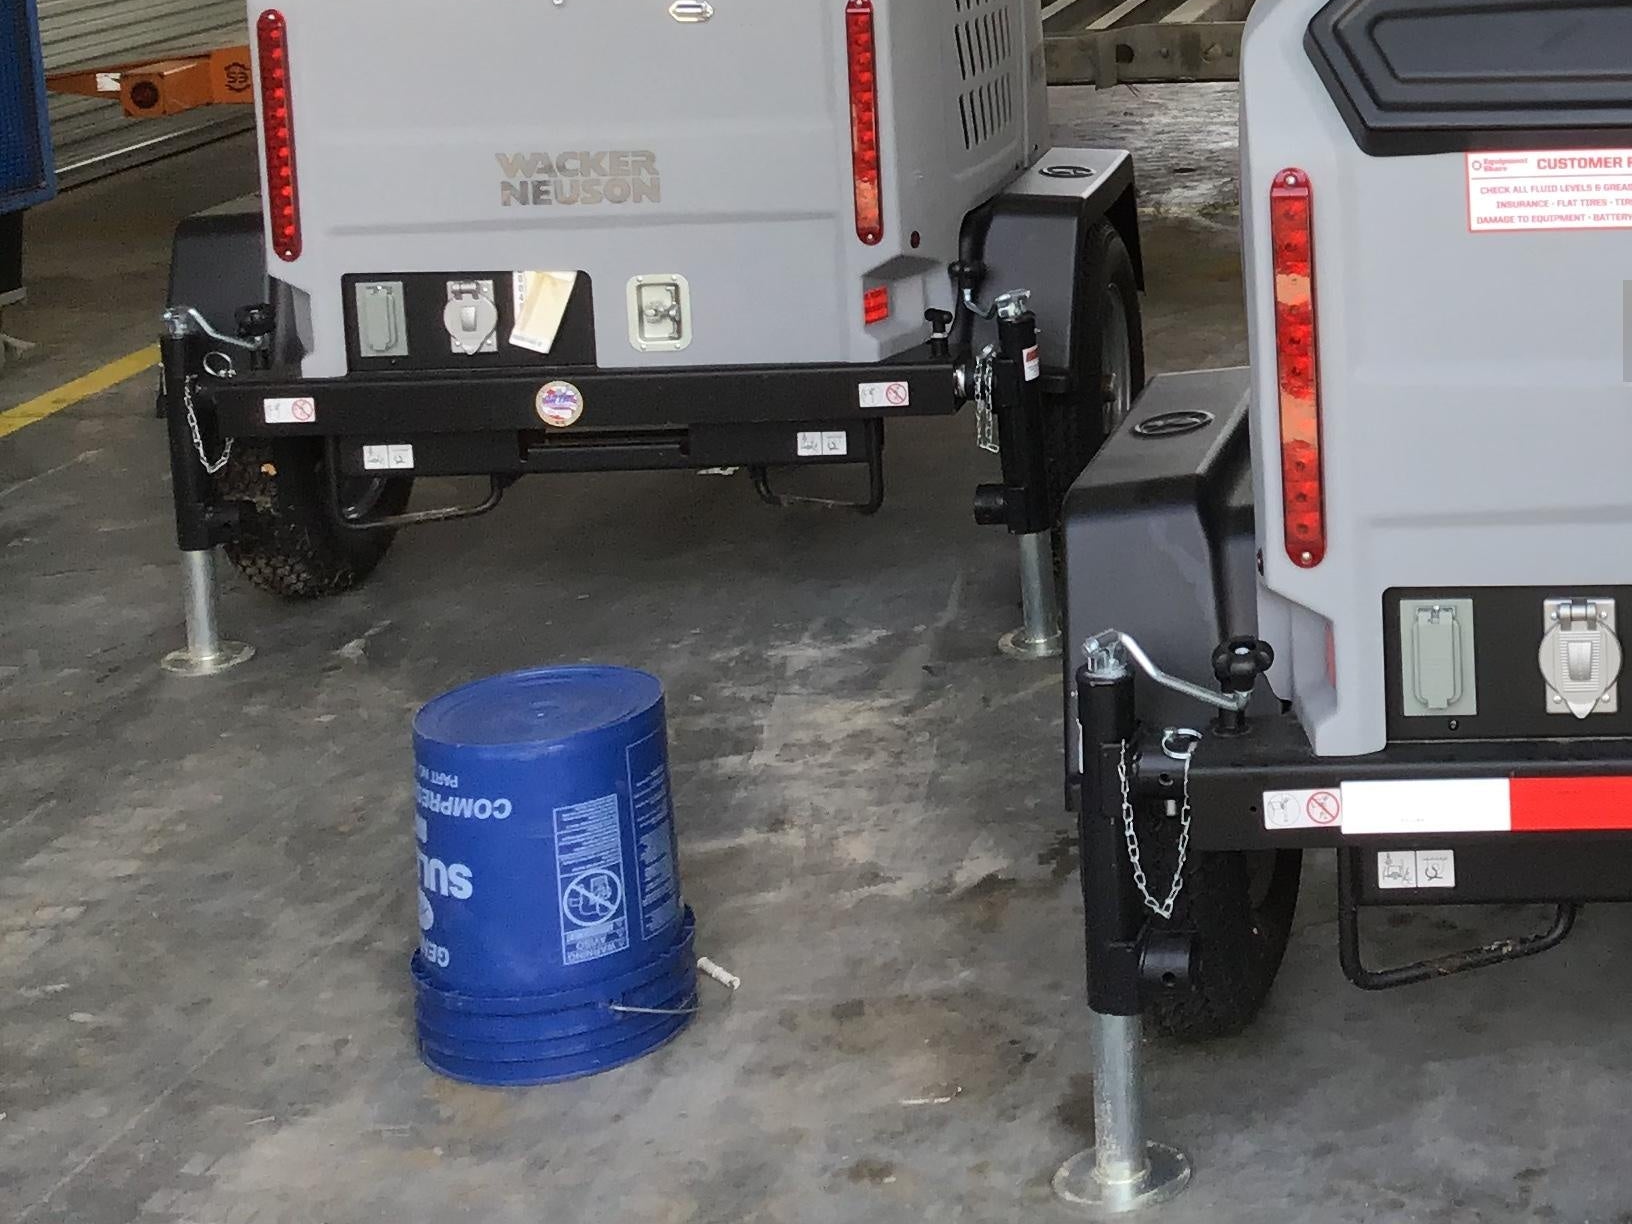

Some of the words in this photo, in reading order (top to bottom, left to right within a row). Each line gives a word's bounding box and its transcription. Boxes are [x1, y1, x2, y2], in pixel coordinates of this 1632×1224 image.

[495, 150, 660, 178] WACKER
[1536, 156, 1623, 170] CUSTOMER
[500, 177, 662, 207] NEUSON
[1479, 185, 1511, 195] CHECK
[1512, 185, 1529, 194] ALL
[1530, 184, 1558, 193] FLUID
[1560, 184, 1593, 192] LEVELS
[1496, 199, 1549, 209] INSURANCE
[1556, 199, 1578, 207] FLAT
[1580, 198, 1608, 207] TIRES
[1476, 216, 1515, 224] DAMAGE
[1518, 215, 1529, 223] TO
[1531, 214, 1586, 224] EQUIPMENT
